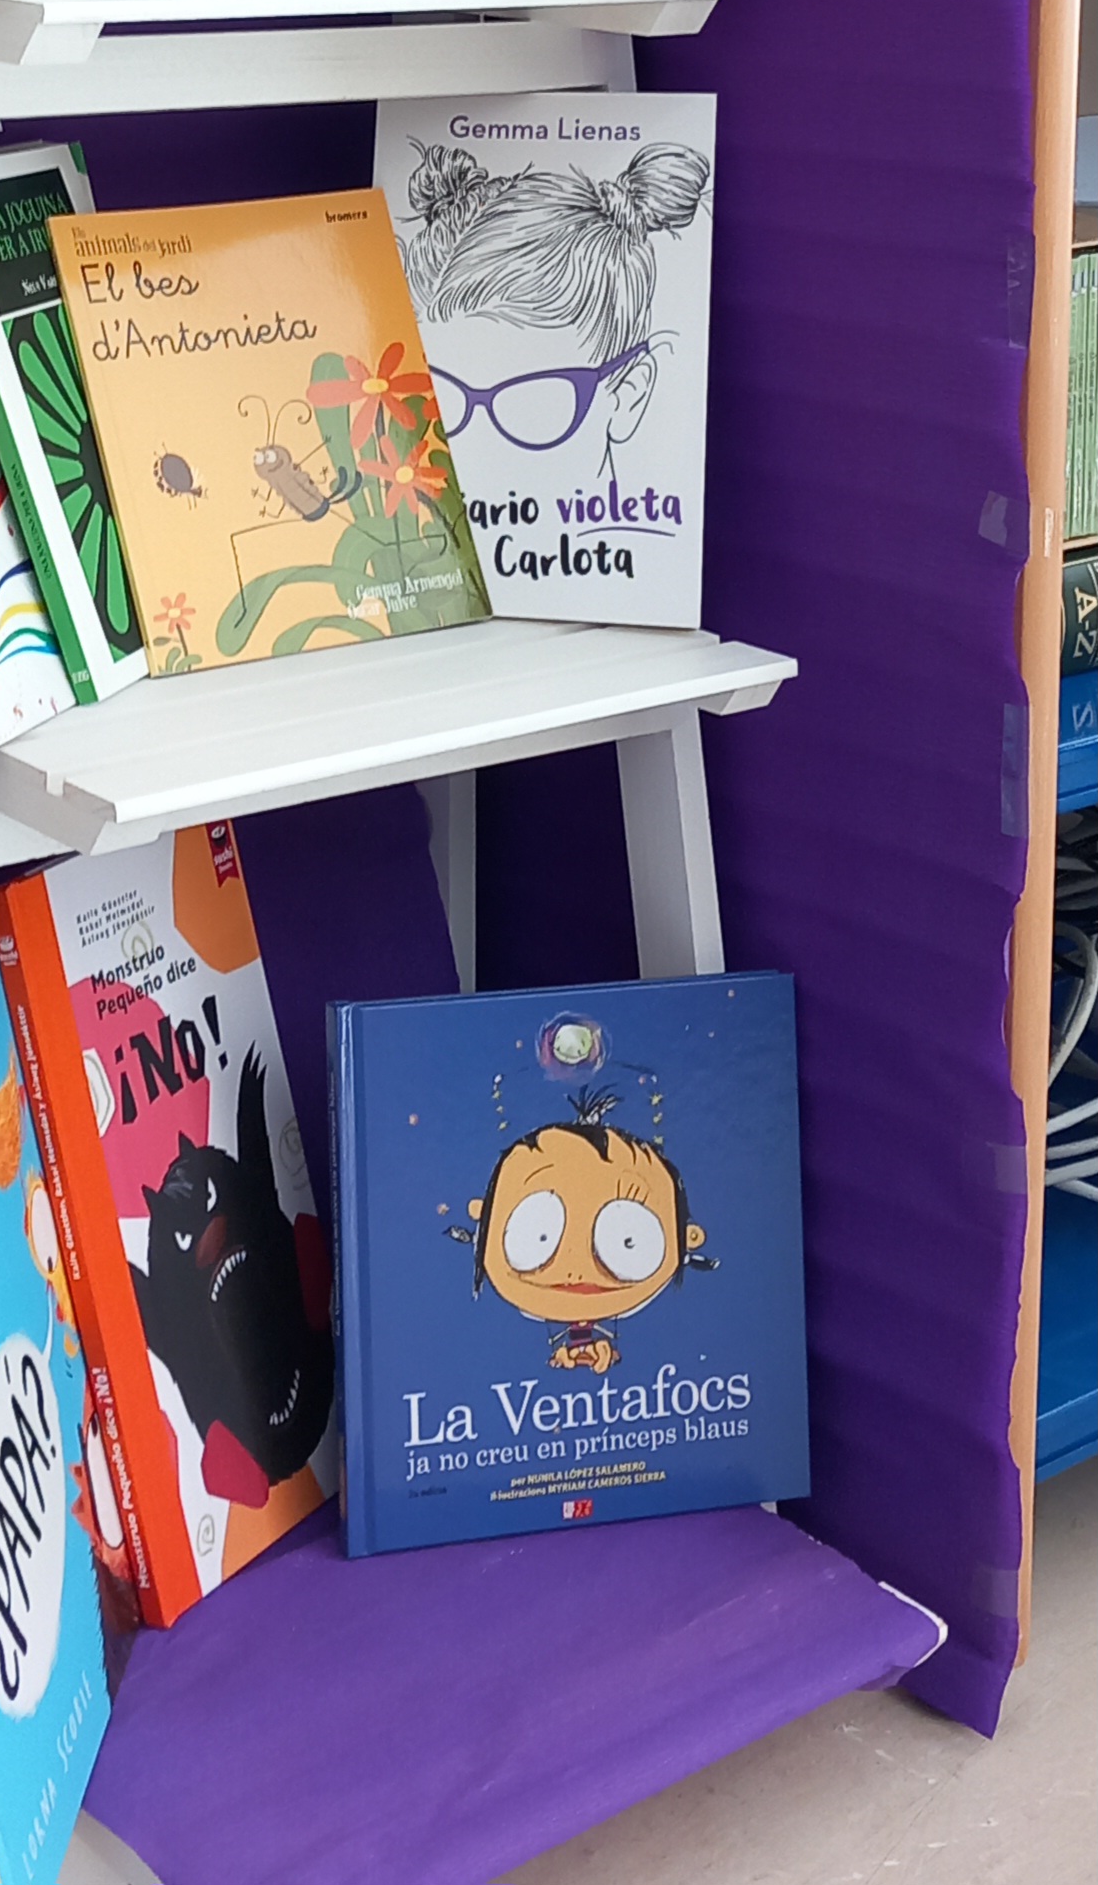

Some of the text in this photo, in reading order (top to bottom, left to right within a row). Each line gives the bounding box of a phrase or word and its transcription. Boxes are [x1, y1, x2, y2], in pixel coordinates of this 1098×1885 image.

[449, 115, 641, 141] Gemma Lienas
[4, 191, 68, 233] JOGUINA
[18, 232, 30, 257] A
[75, 232, 141, 257] animals
[80, 261, 124, 304] El
[133, 260, 200, 299] bes
[92, 311, 317, 361] d'Antonieta
[556, 480, 682, 525] violeta
[494, 533, 634, 581] Carlota
[356, 568, 464, 600] Gemma Armengol
[90, 945, 165, 994] Monstruo
[96, 957, 197, 1021] Pequeño dice
[105, 1408, 119, 1440] dice
[402, 1364, 751, 1448] La Ventafocs
[405, 1418, 749, 1481] ja no creu en prínceps blaus
[112, 1443, 134, 1509] Pequeño
[564, 1466, 594, 1480] LÓPEZ
[128, 1512, 150, 1589] Monstruo
